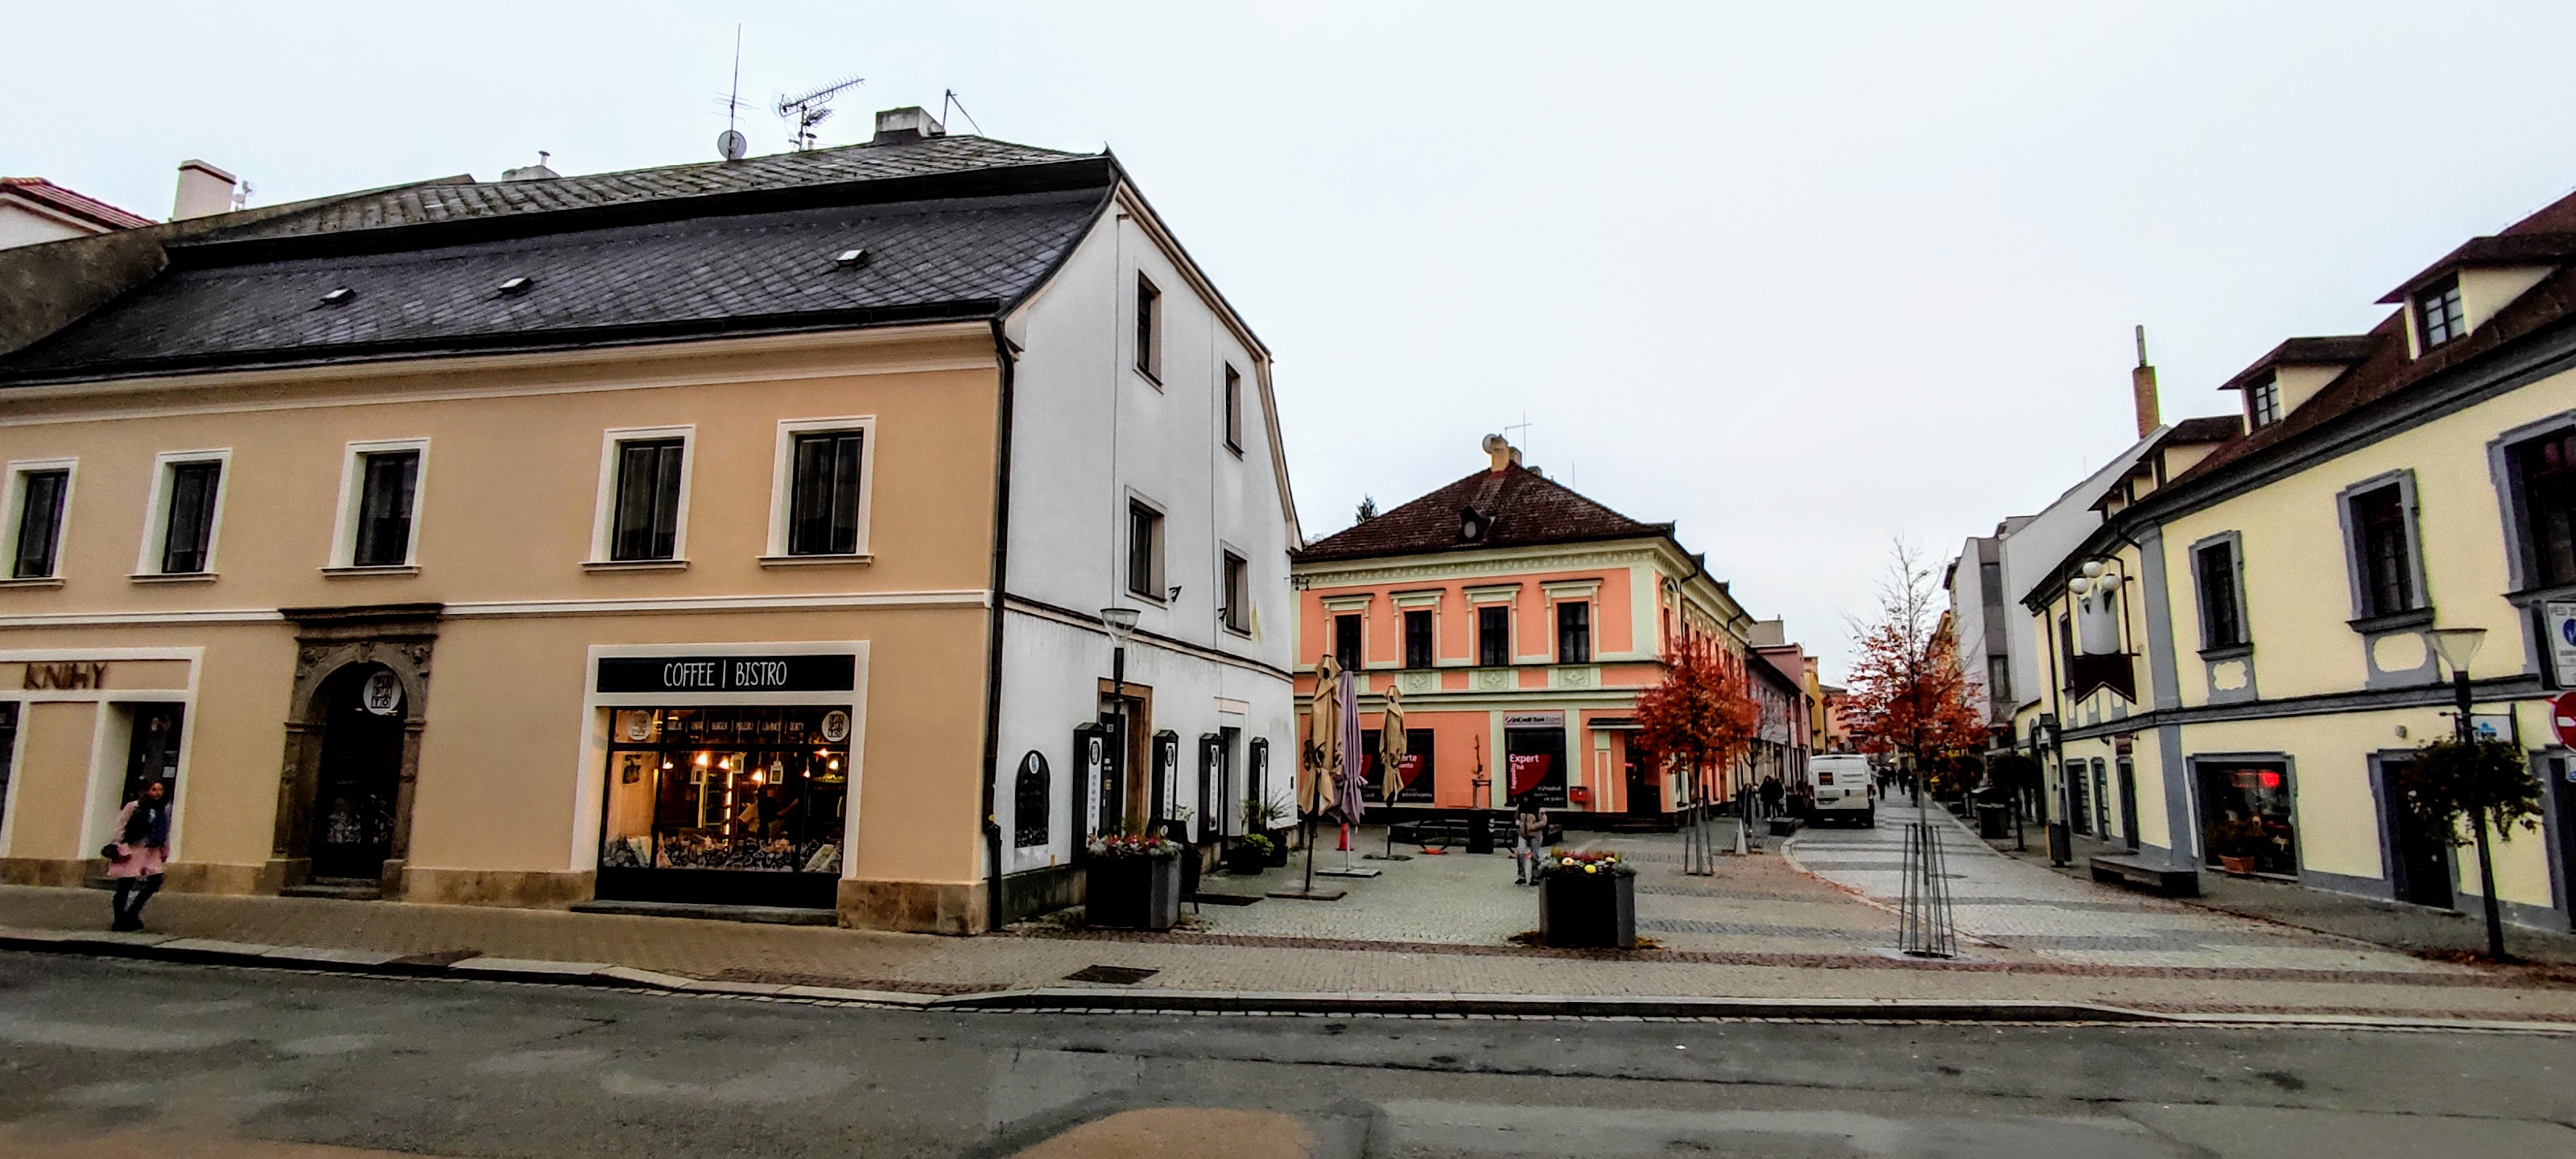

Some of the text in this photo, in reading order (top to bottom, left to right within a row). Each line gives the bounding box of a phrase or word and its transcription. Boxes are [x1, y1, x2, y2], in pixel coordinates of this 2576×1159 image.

[23, 662, 108, 690] KNIHY
[663, 662, 787, 687] COFFEE BISTRO
[1509, 754, 1539, 764] Expert
